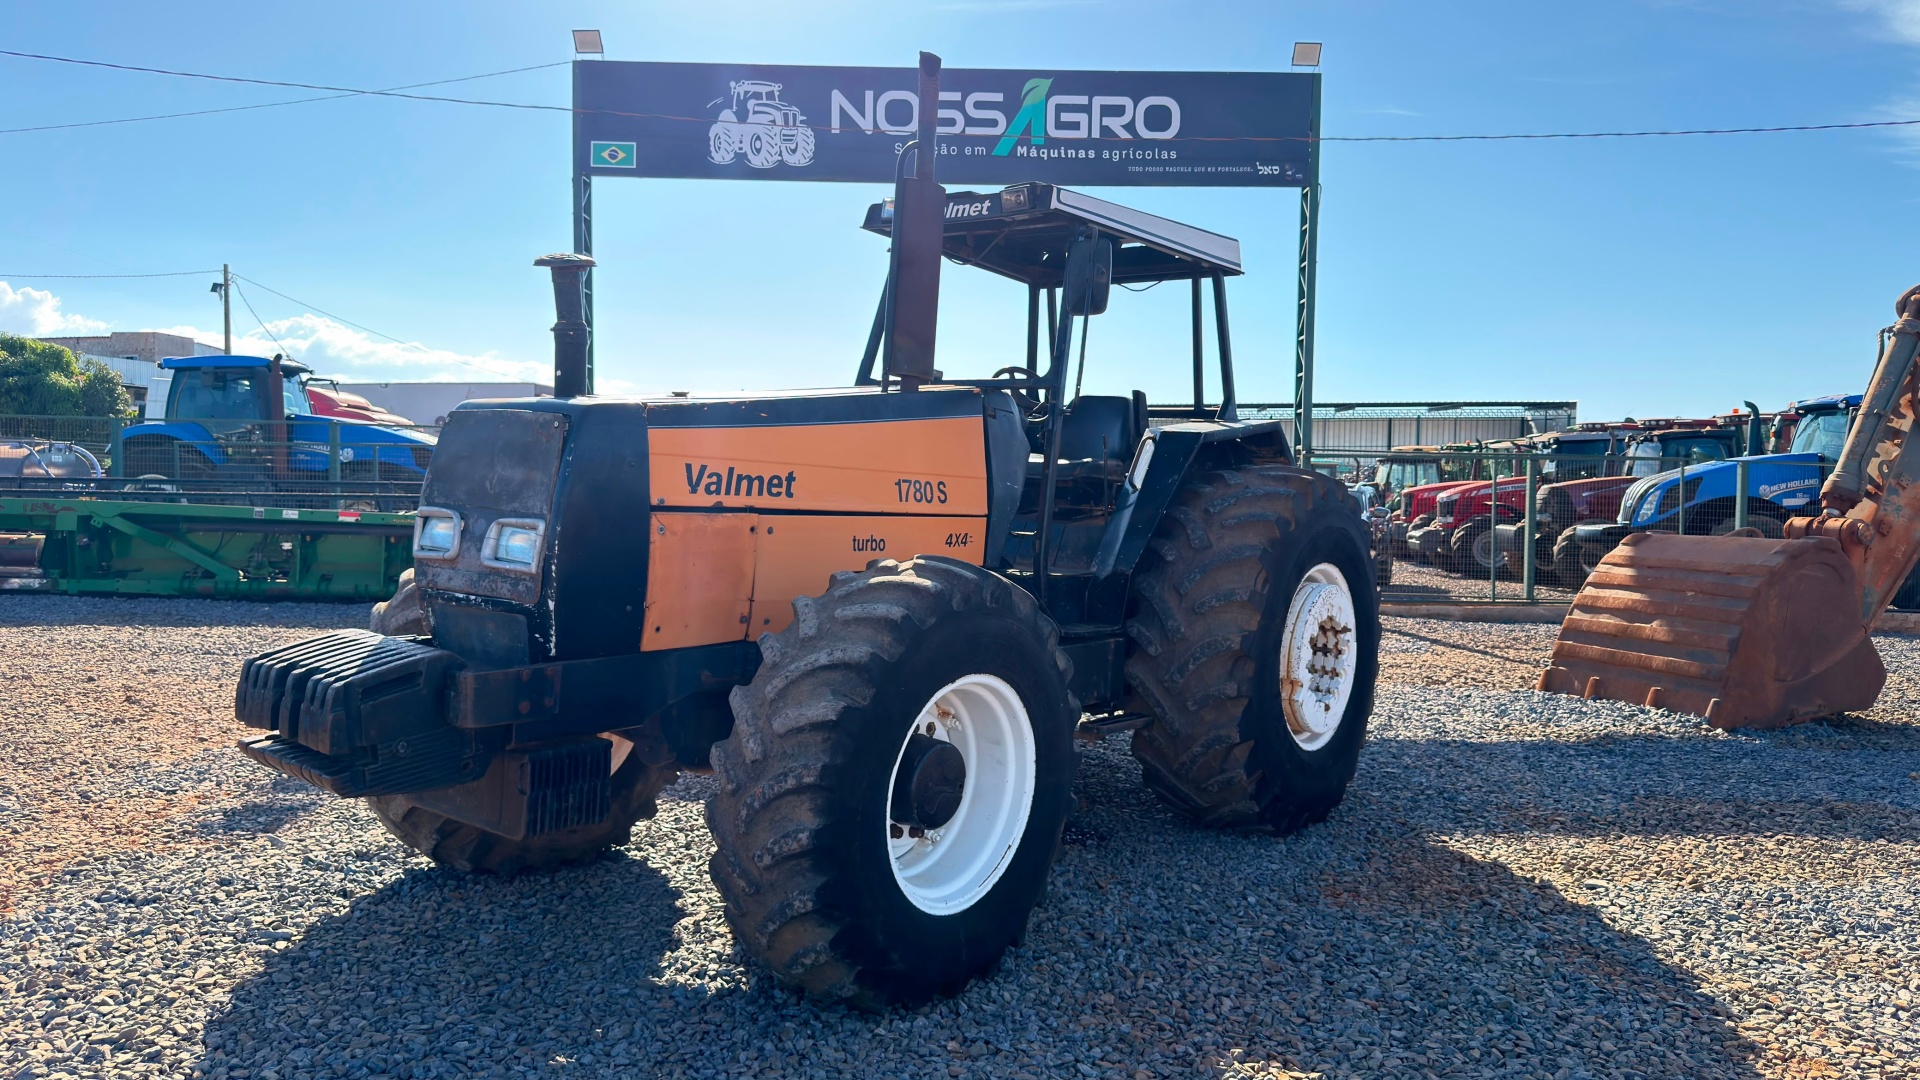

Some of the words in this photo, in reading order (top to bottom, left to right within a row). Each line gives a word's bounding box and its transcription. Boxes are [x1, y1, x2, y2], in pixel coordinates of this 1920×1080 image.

[965, 145, 986, 155] em
[1017, 145, 1096, 160] Máquinas
[1102, 147, 1177, 161] agrícolas
[944, 200, 991, 218] lmet
[684, 463, 796, 498] Valmet
[1770, 482, 1787, 493] NEW
[1787, 478, 1819, 488] HOLLAND
[895, 478, 934, 504] 1780
[937, 480, 948, 504] S
[852, 534, 886, 552] turbo
[945, 532, 969, 548] 4X4
